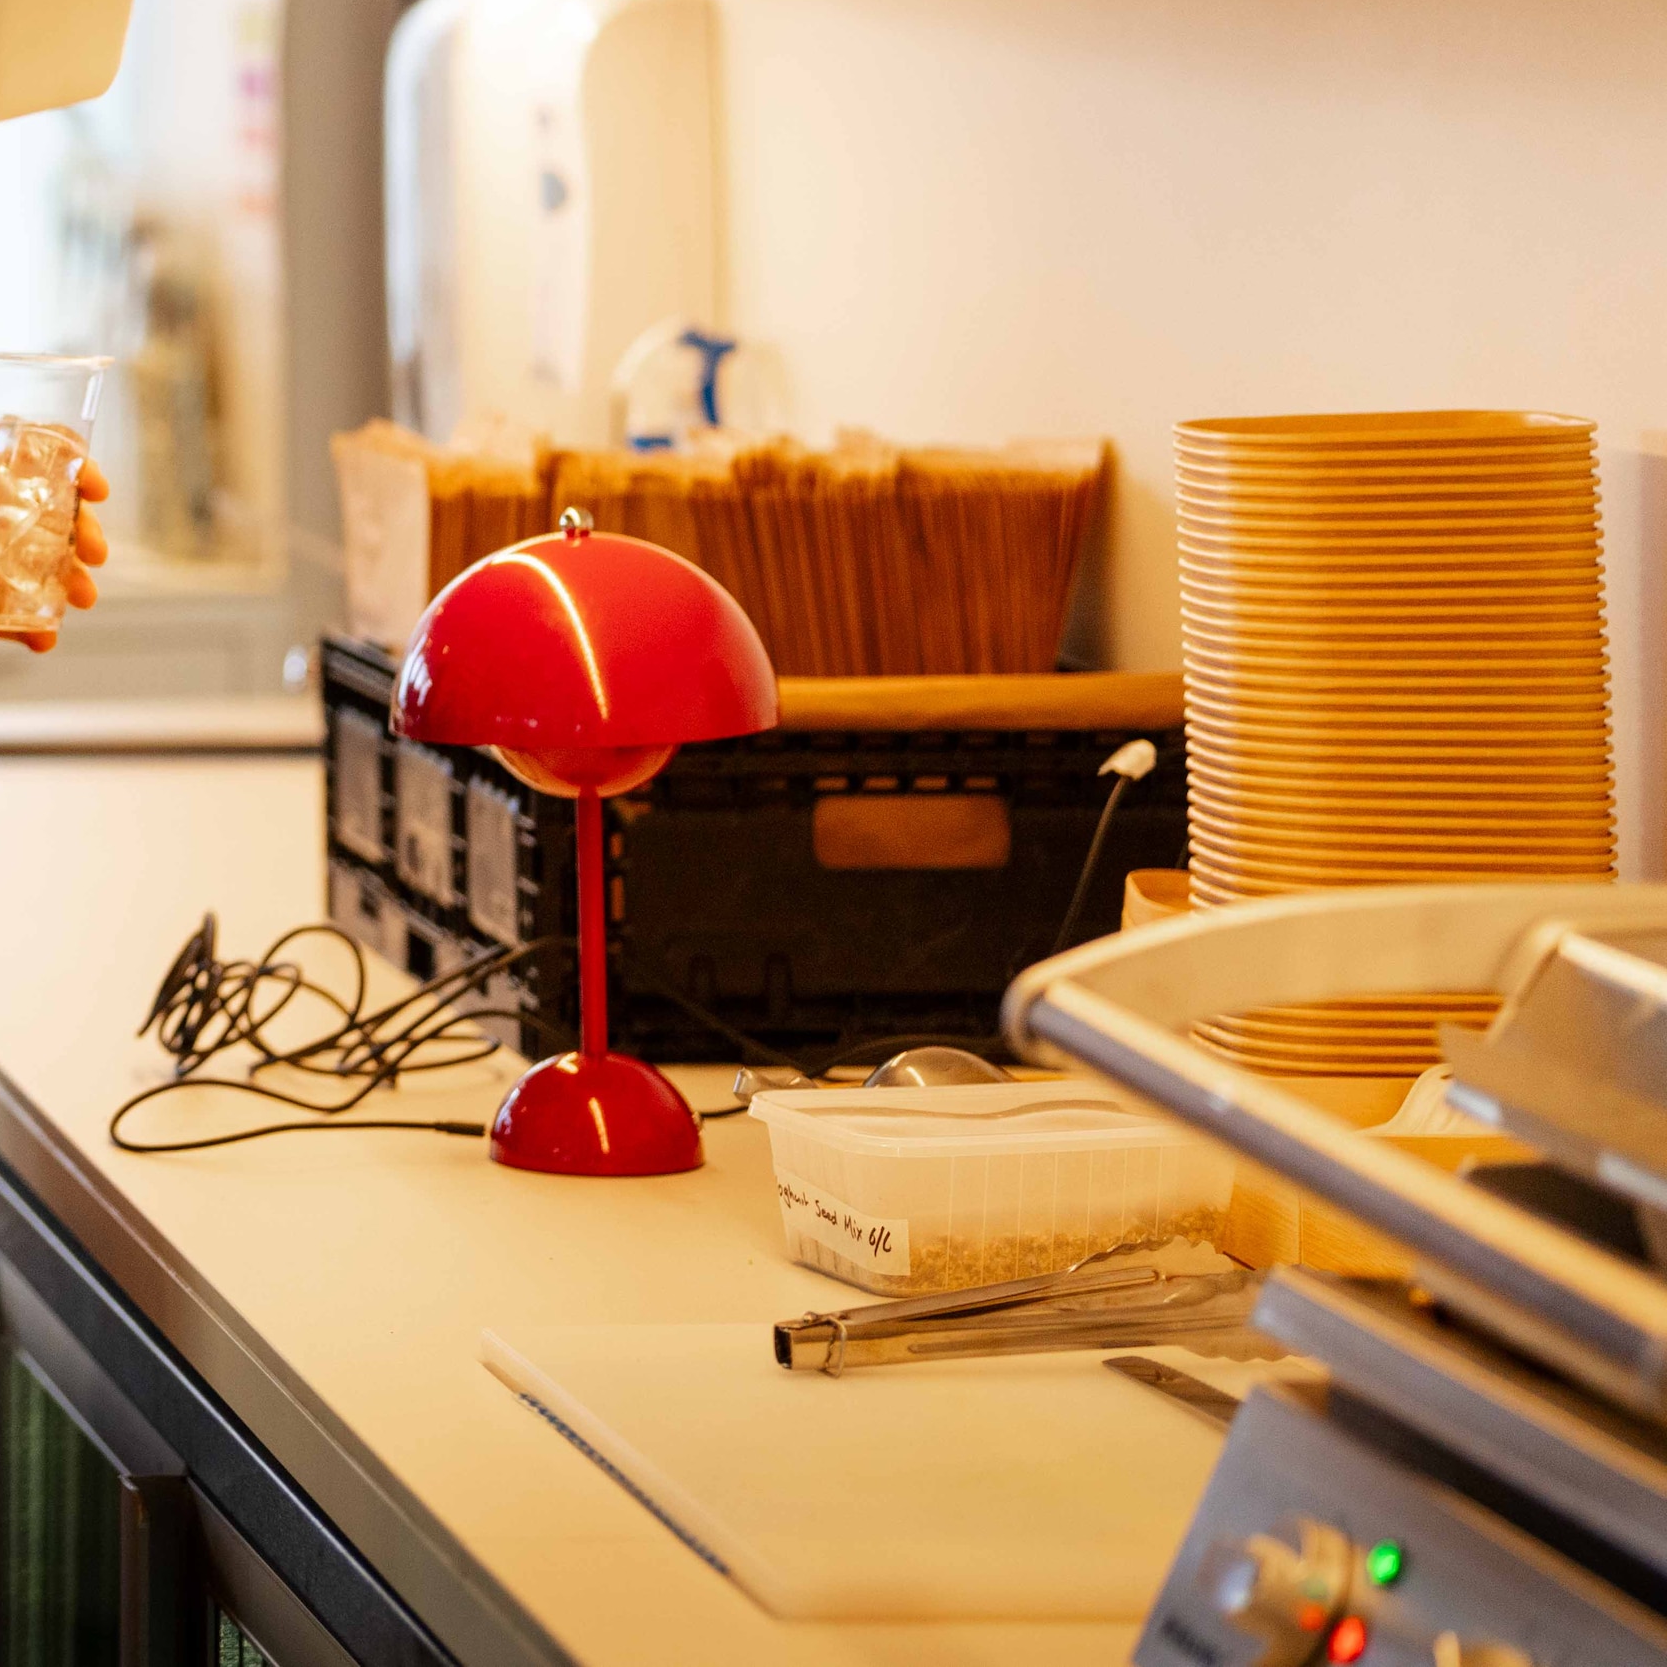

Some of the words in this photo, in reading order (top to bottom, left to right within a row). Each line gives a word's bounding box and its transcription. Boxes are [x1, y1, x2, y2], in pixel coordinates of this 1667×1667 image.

[778, 1183, 809, 1209] oghurt
[815, 1199, 838, 1225] Seed
[844, 1214, 863, 1242] Mix
